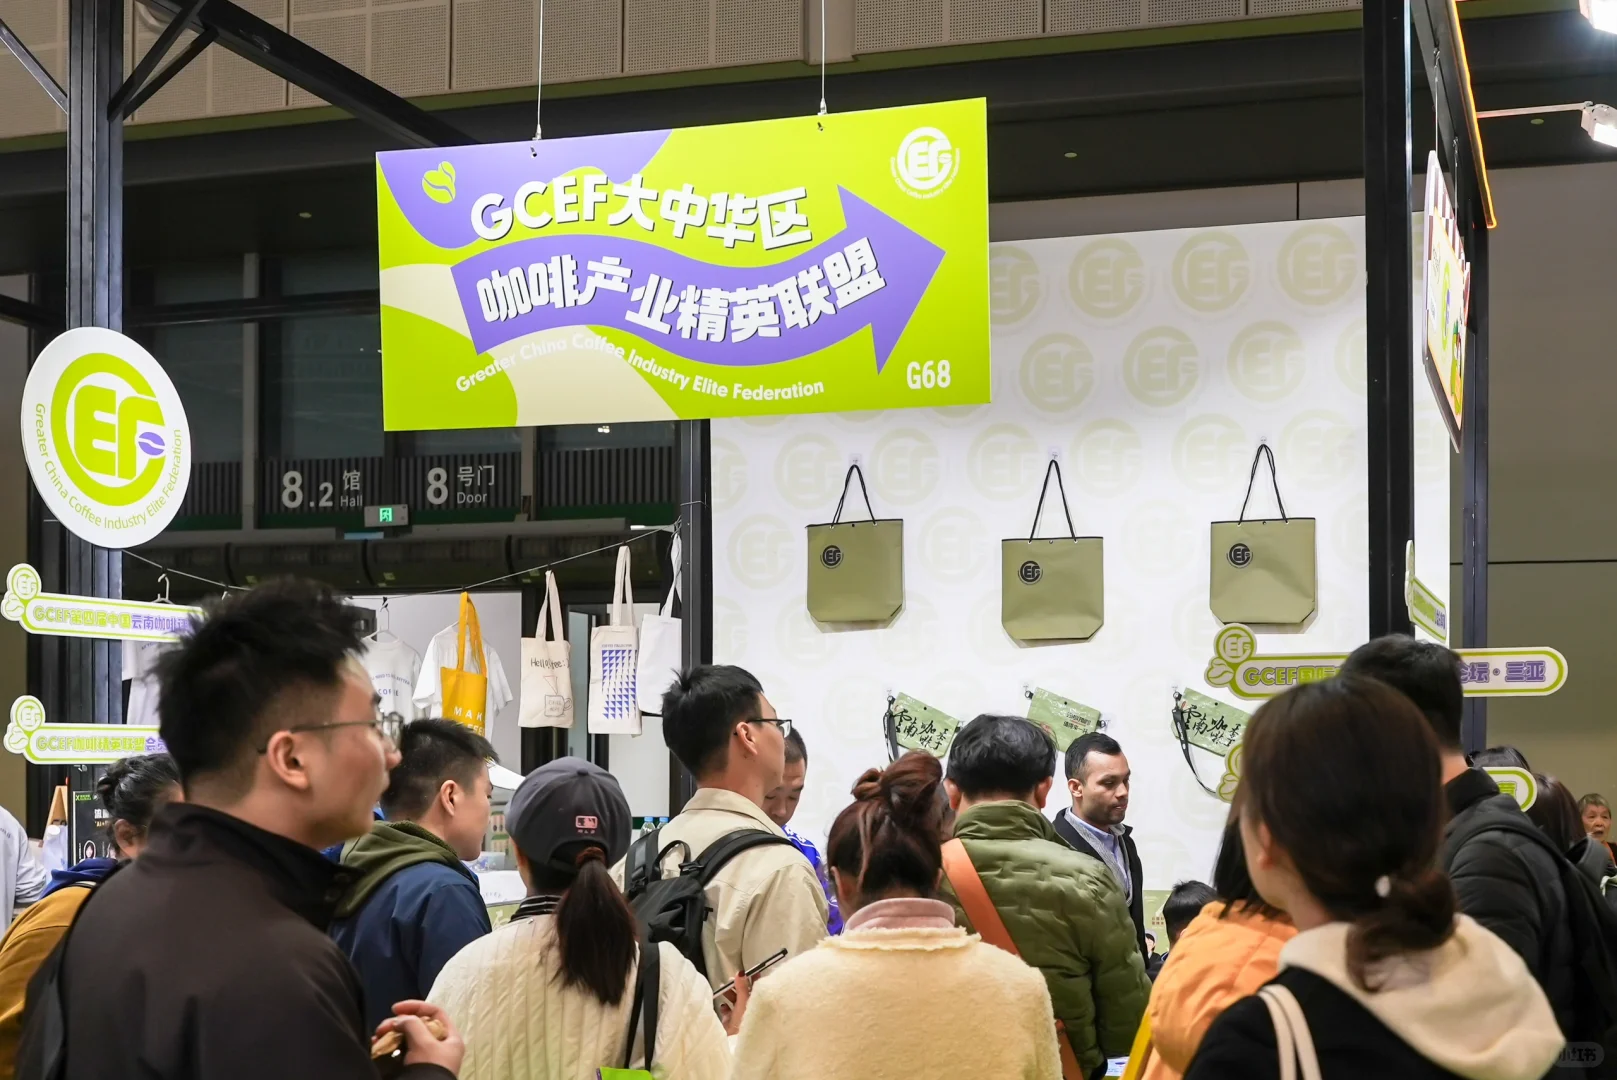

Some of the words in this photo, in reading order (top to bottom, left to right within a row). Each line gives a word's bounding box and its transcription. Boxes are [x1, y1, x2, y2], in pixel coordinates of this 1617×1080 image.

[470, 174, 813, 250] GCEF大中华区
[476, 236, 886, 344] 咖啡产业精英联盟
[455, 354, 517, 392] Greater
[520, 336, 568, 360] China
[571, 332, 625, 360] Coffee
[627, 348, 690, 391] Industry
[692, 374, 729, 399] Elite
[732, 379, 825, 402] Federation
[906, 360, 952, 391] G68
[35, 403, 48, 458] Greater
[44, 460, 69, 499] China
[69, 496, 102, 527] Coffee
[104, 511, 147, 530] Industry
[147, 496, 167, 518] Elite
[162, 429, 183, 499] Federation
[426, 467, 448, 504] 8
[457, 465, 495, 487] 号门
[282, 470, 333, 509] 8.2
[342, 470, 361, 491] 馆
[340, 495, 363, 507] Hall
[457, 492, 488, 504] Door
[1243, 666, 1339, 686] GCEF国际
